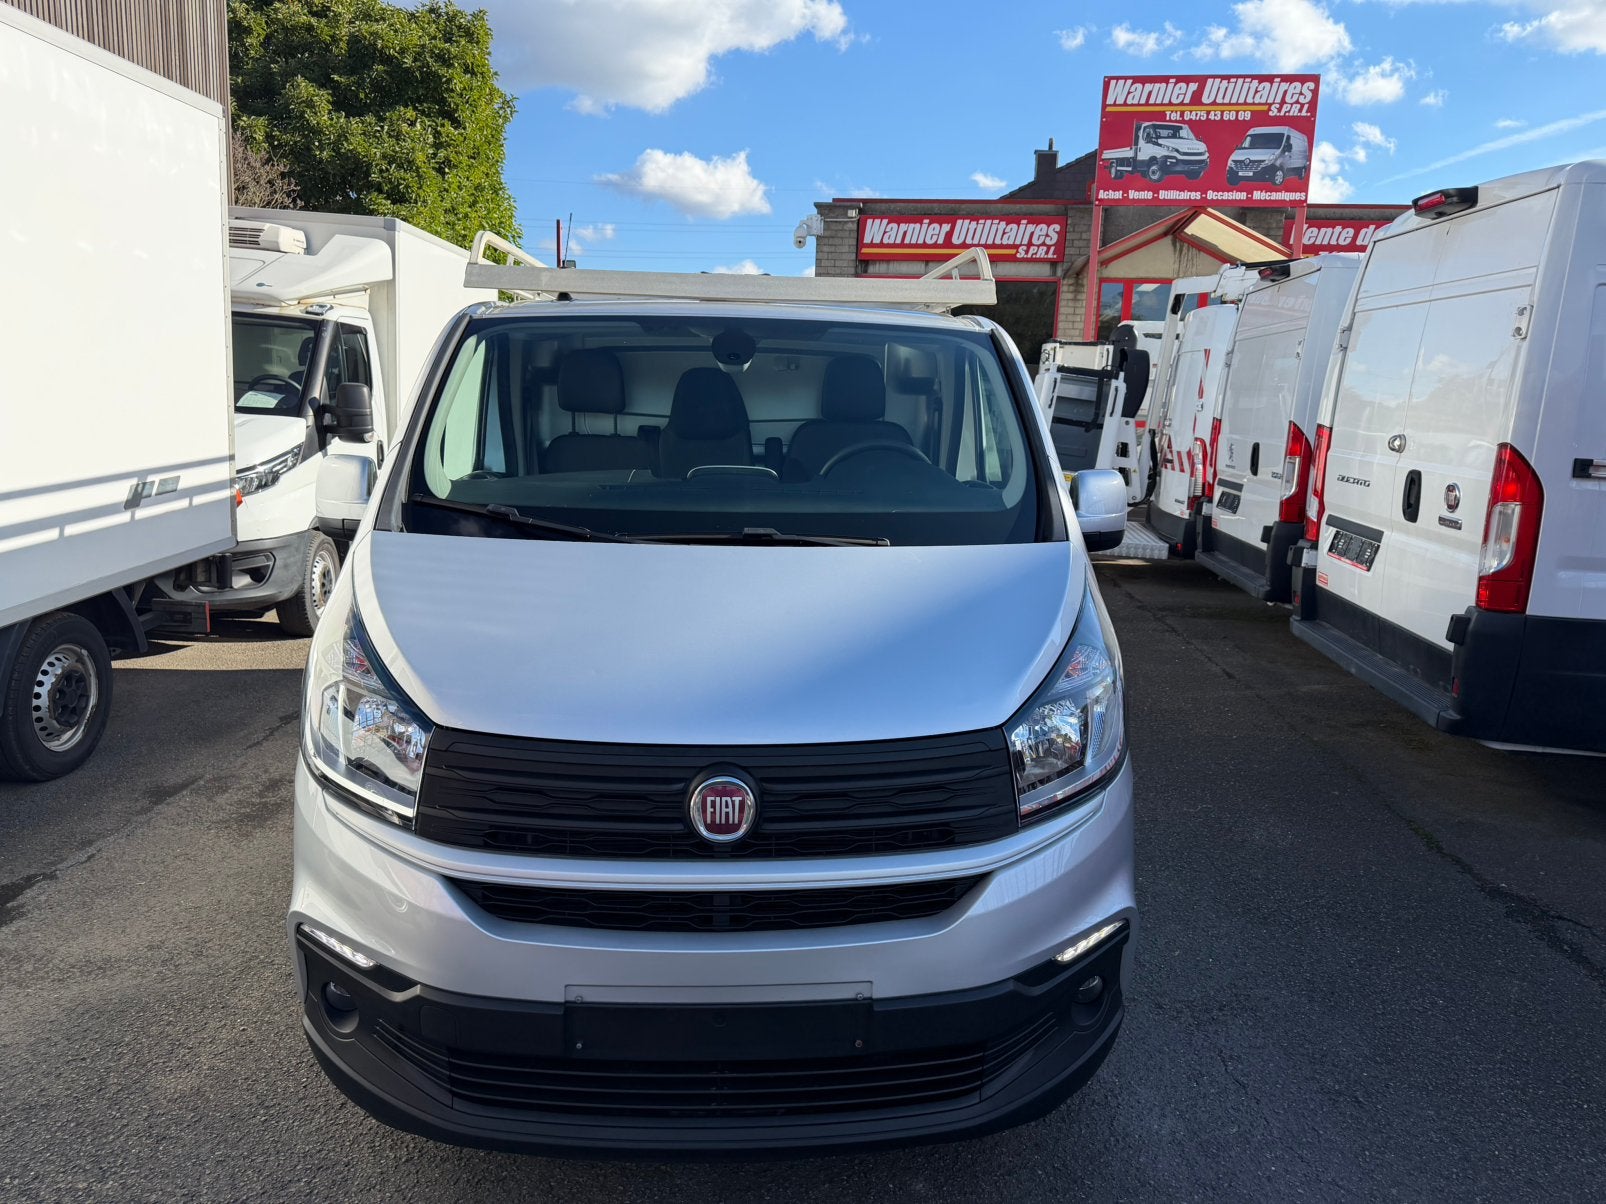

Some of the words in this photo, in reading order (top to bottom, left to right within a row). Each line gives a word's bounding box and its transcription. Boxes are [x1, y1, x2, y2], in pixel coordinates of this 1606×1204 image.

[1106, 79, 1198, 104] Warnier
[1202, 78, 1315, 104] Utilitaires
[1184, 110, 1207, 121] 0475
[1209, 110, 1221, 121] 43
[1268, 103, 1311, 117] S.P.R.L.
[1098, 189, 1123, 200] Achat
[1128, 190, 1153, 200] Vente
[1158, 189, 1201, 201] Utilitaires
[1207, 190, 1247, 201] Occasion
[1253, 190, 1306, 201] Mécaniques
[863, 219, 950, 244] Warnier
[952, 220, 1060, 245] Utilitaires
[1016, 246, 1057, 258] S.P.R.L.
[706, 796, 743, 825] FIAT
